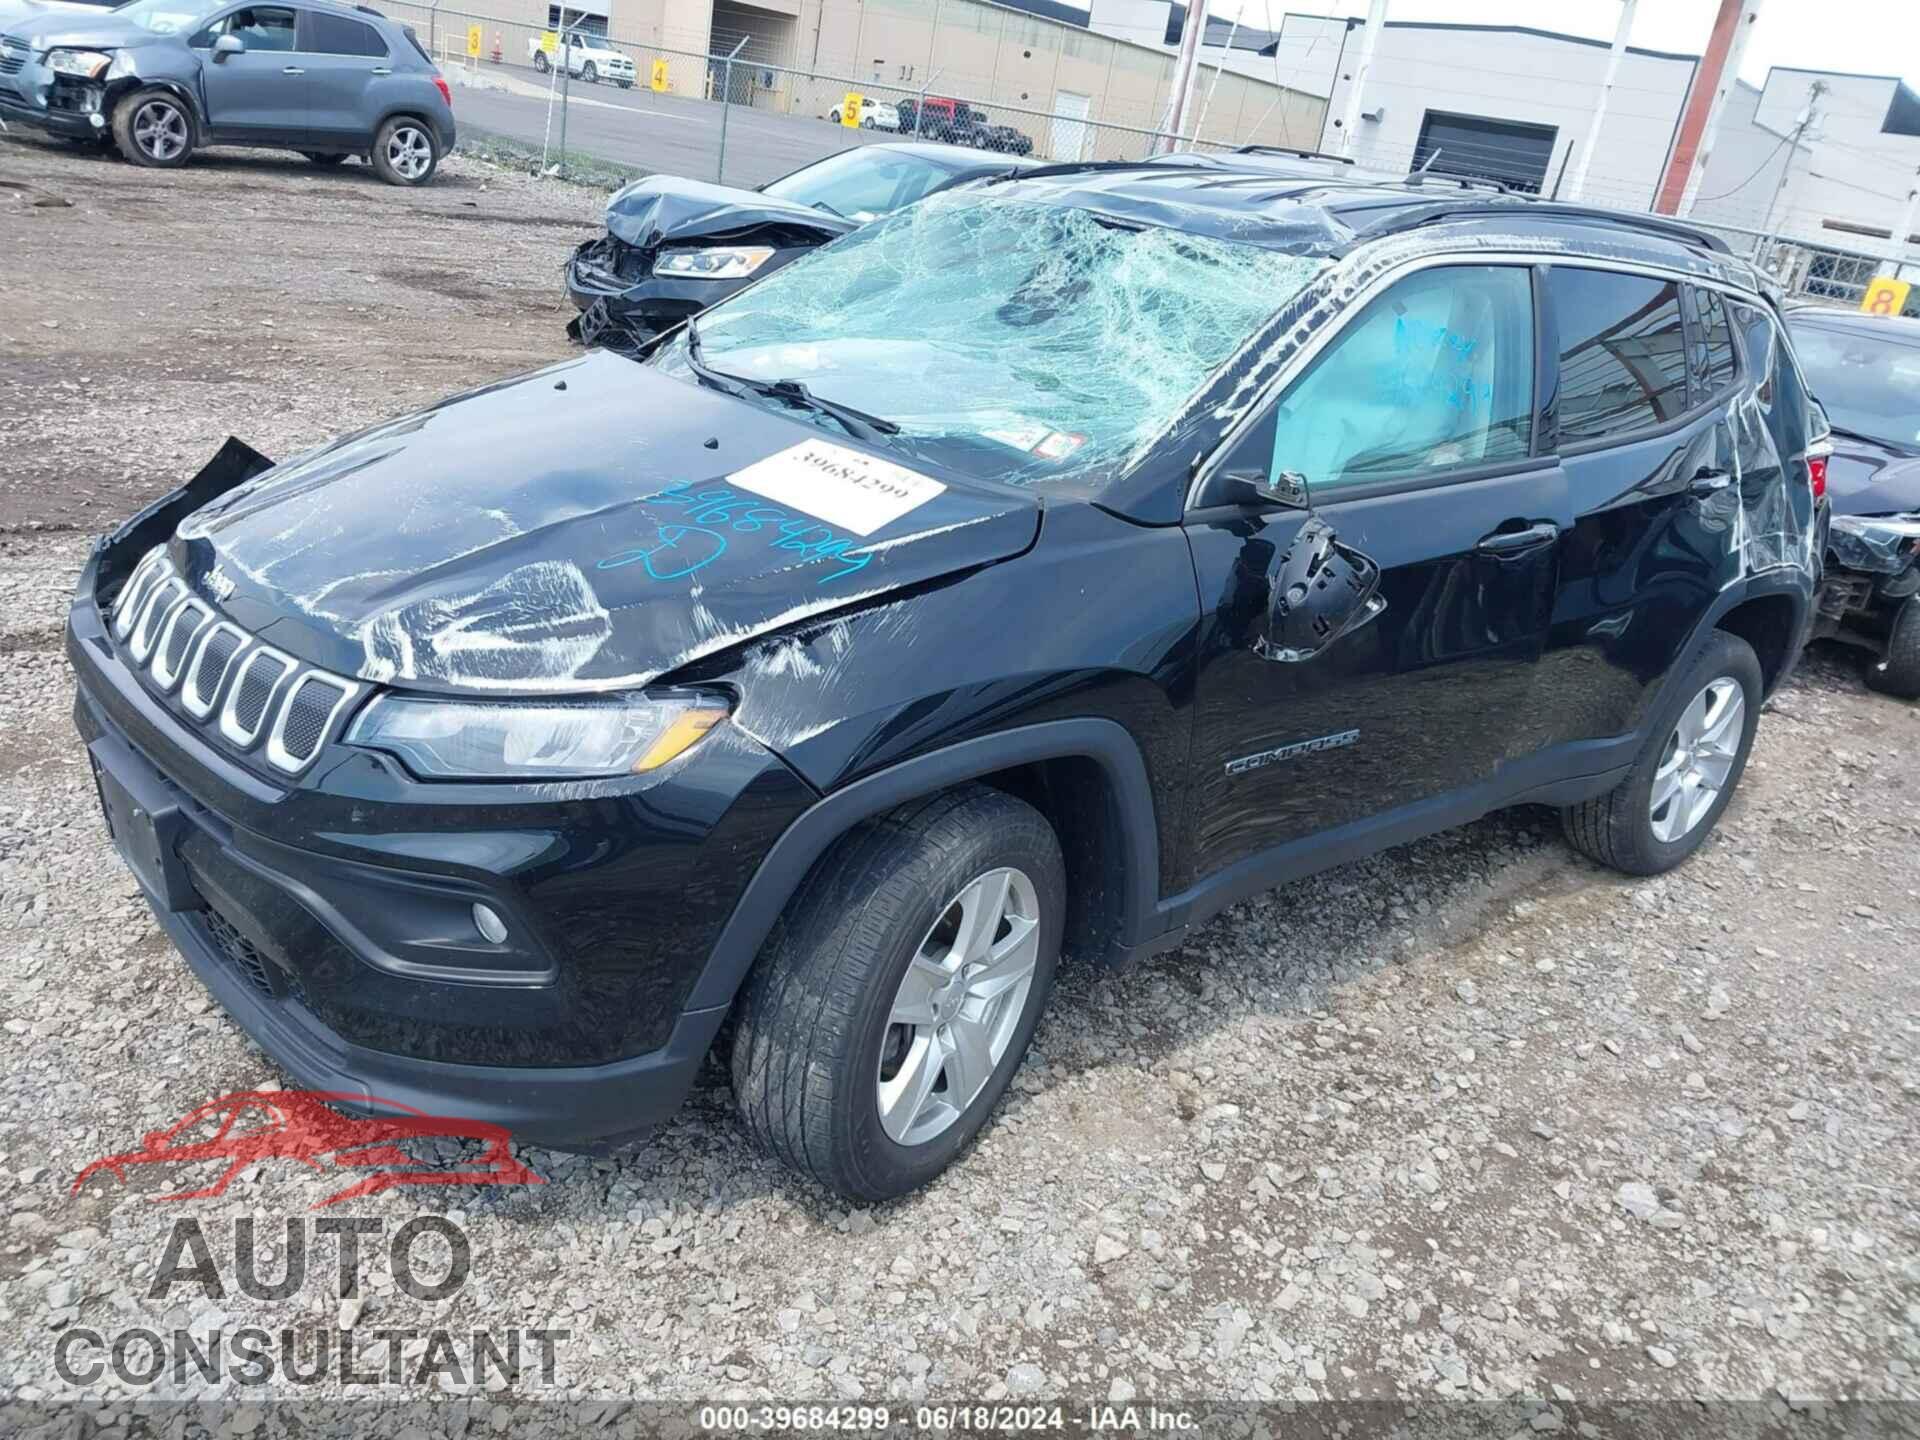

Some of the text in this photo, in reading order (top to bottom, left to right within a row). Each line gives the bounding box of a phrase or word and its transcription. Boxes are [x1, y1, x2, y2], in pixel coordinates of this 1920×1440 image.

[471, 33, 479, 49] 3
[655, 67, 663, 85] 4
[847, 100, 858, 120] 5
[1871, 289, 1895, 315] 8
